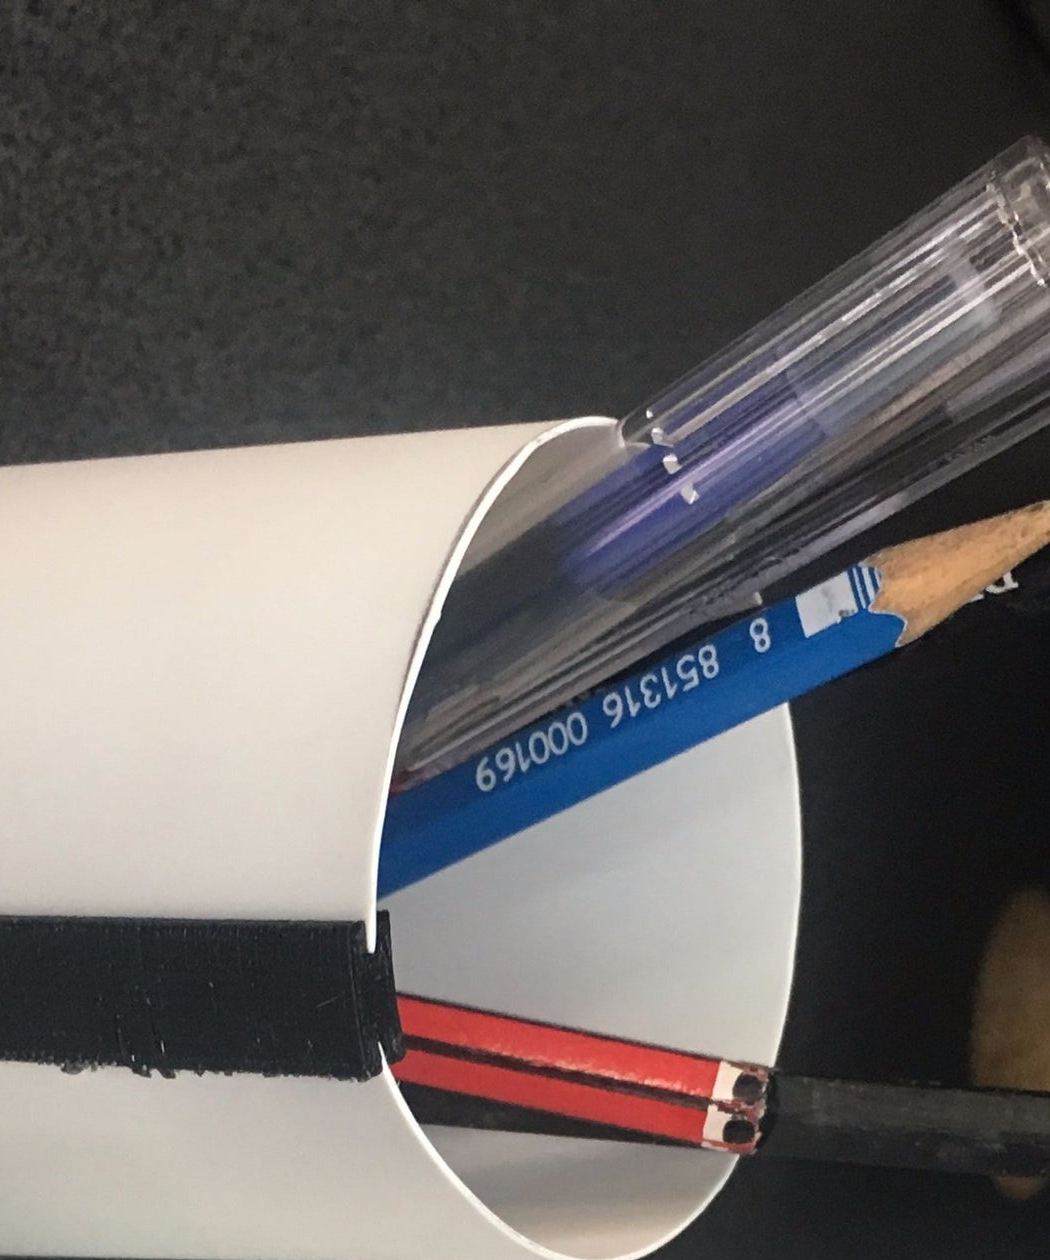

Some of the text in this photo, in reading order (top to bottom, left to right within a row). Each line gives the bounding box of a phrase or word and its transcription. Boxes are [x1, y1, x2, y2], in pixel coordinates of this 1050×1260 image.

[474, 617, 772, 793] 8 851316 000169
